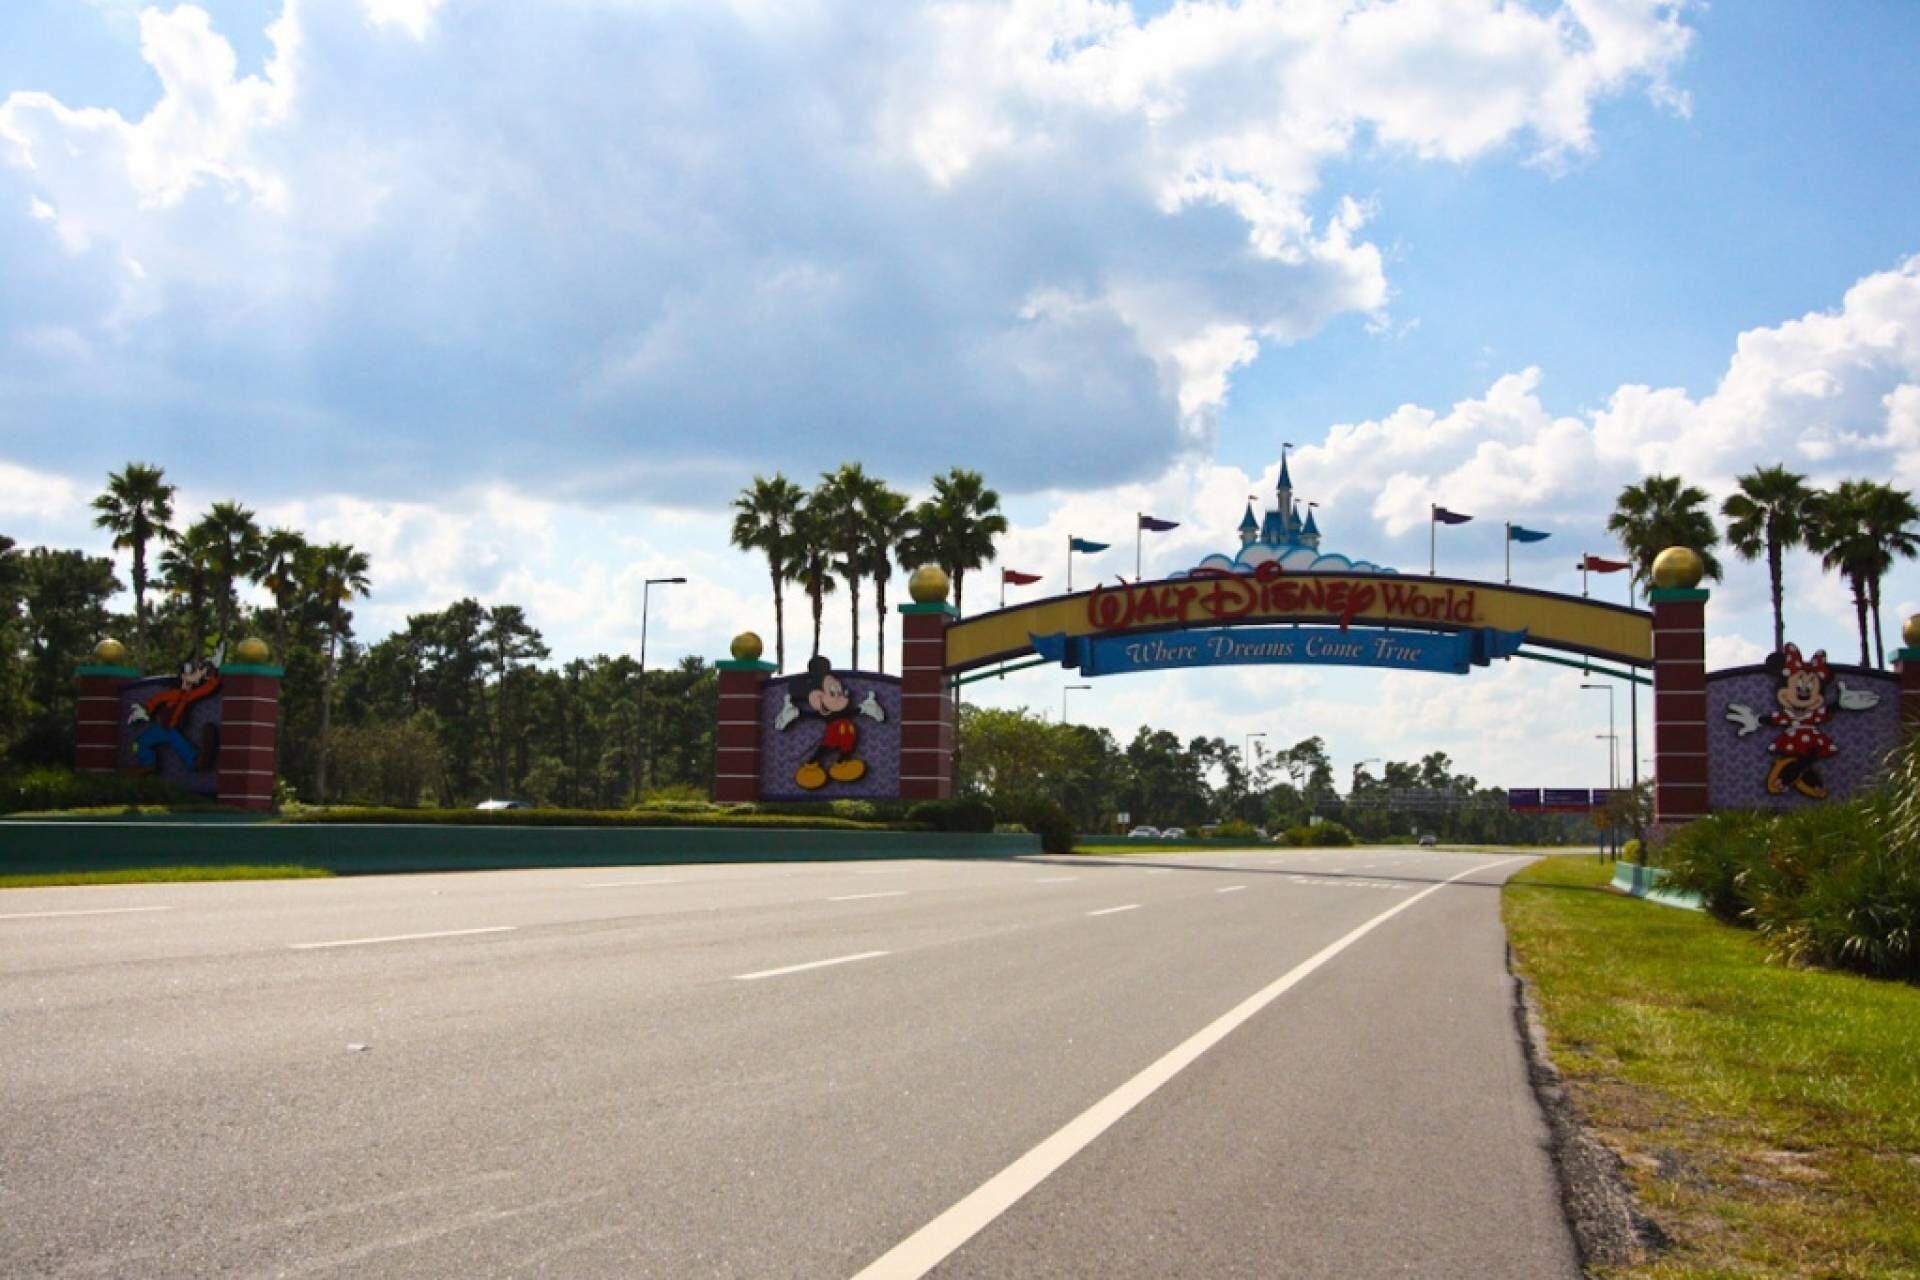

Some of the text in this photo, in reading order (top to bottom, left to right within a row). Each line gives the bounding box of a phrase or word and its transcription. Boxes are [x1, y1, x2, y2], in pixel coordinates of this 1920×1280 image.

[1384, 581, 1476, 623] World
[1125, 635, 1422, 665] Where Dreams Come True
